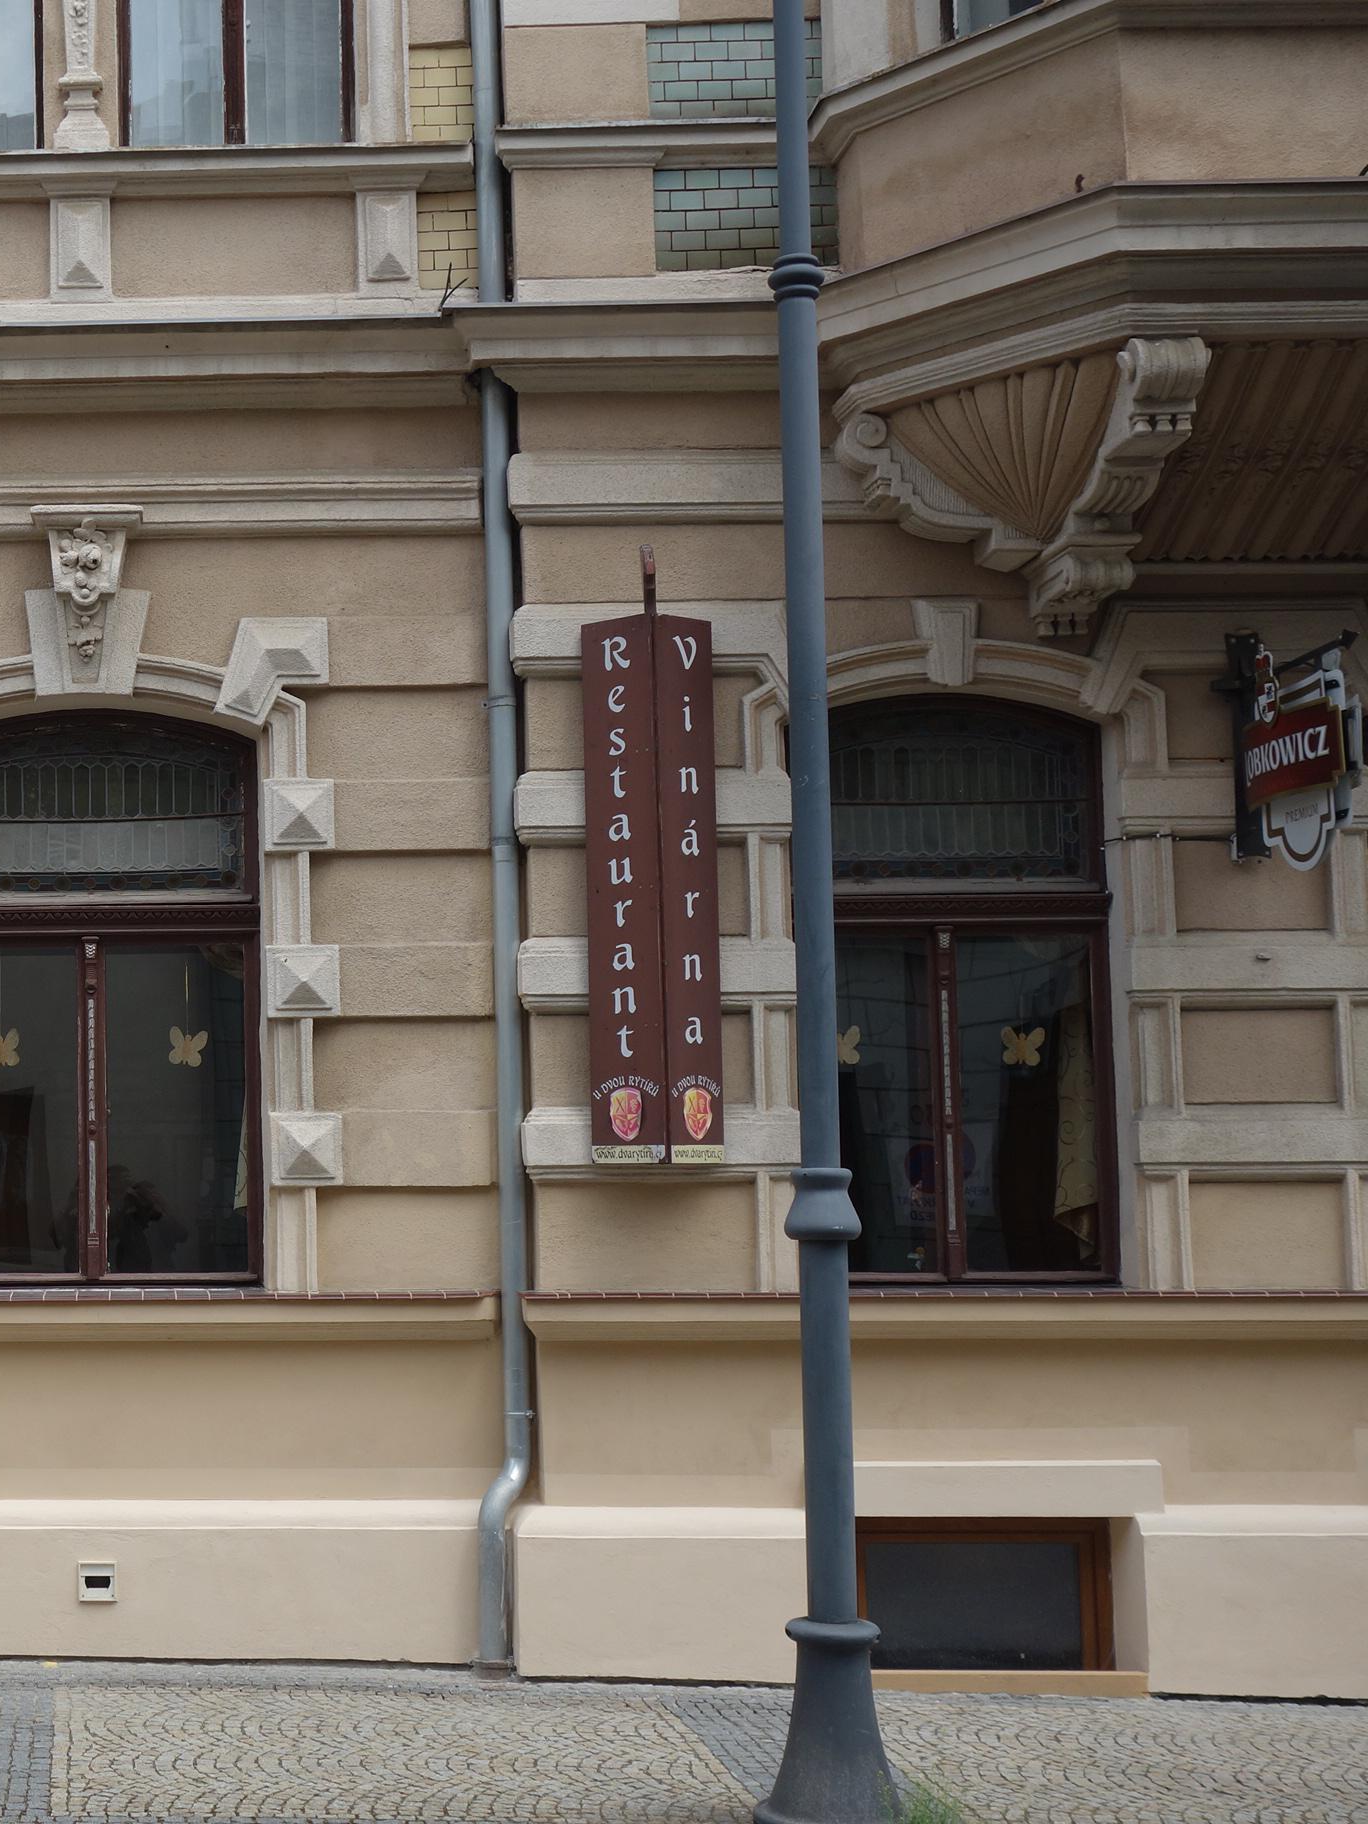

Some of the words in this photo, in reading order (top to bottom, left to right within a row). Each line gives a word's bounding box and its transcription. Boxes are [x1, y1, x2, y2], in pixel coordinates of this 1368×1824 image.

[1244, 725, 1330, 787] LOBKOWICZ
[601, 635, 637, 1059] Restaurant
[672, 634, 705, 1047] Vinárna
[592, 1090, 602, 1100] U
[600, 1076, 626, 1094] DVOU
[672, 1087, 679, 1098] U
[677, 1075, 696, 1092] DVOU
